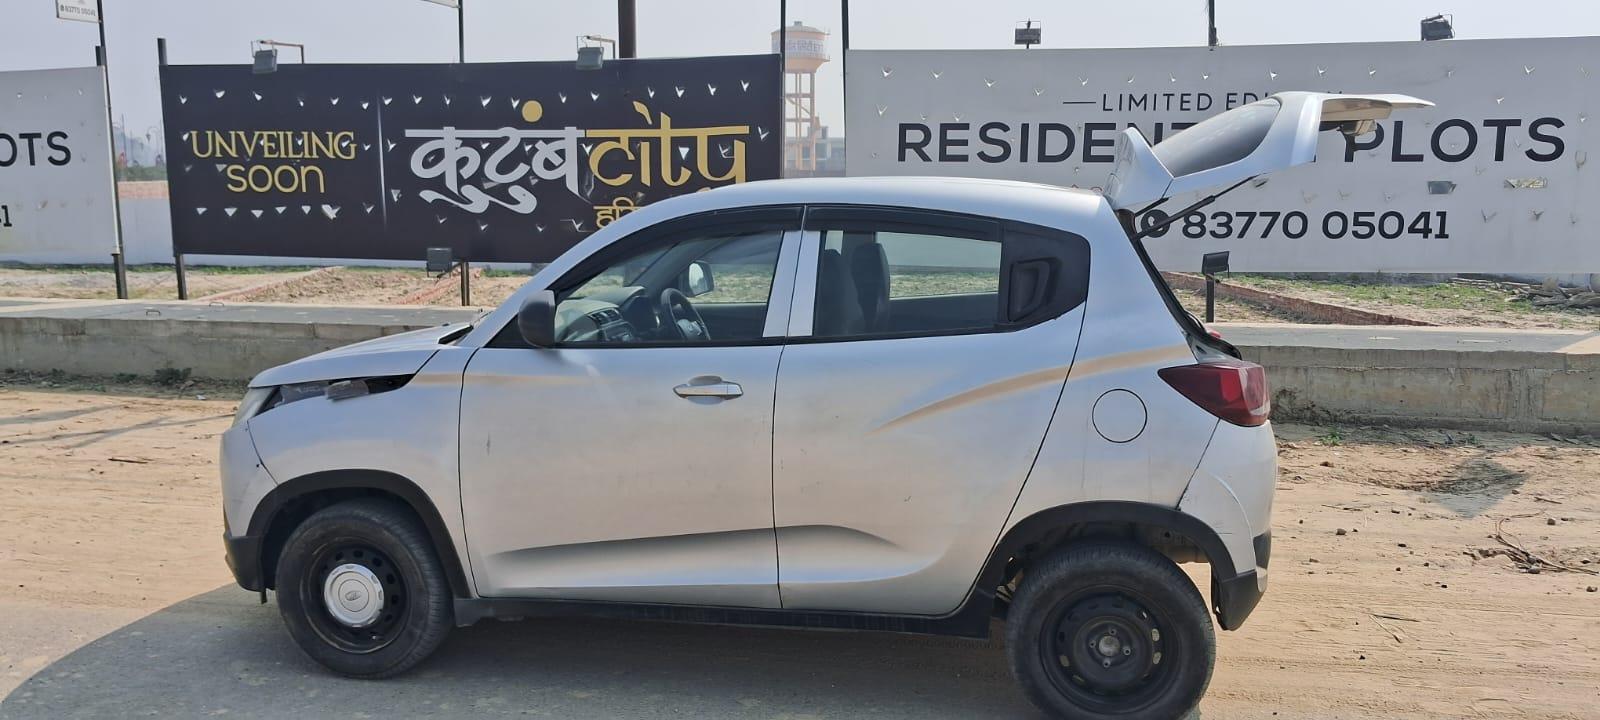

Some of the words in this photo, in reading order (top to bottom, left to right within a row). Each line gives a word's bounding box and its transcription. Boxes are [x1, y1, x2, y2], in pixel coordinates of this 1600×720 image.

[1102, 92, 1213, 112] LIMITED
[190, 130, 358, 160] UNVEILING
[1344, 116, 1566, 163] PLOTS
[1181, 210, 1309, 240] 83770
[1321, 210, 1450, 240] 05041
